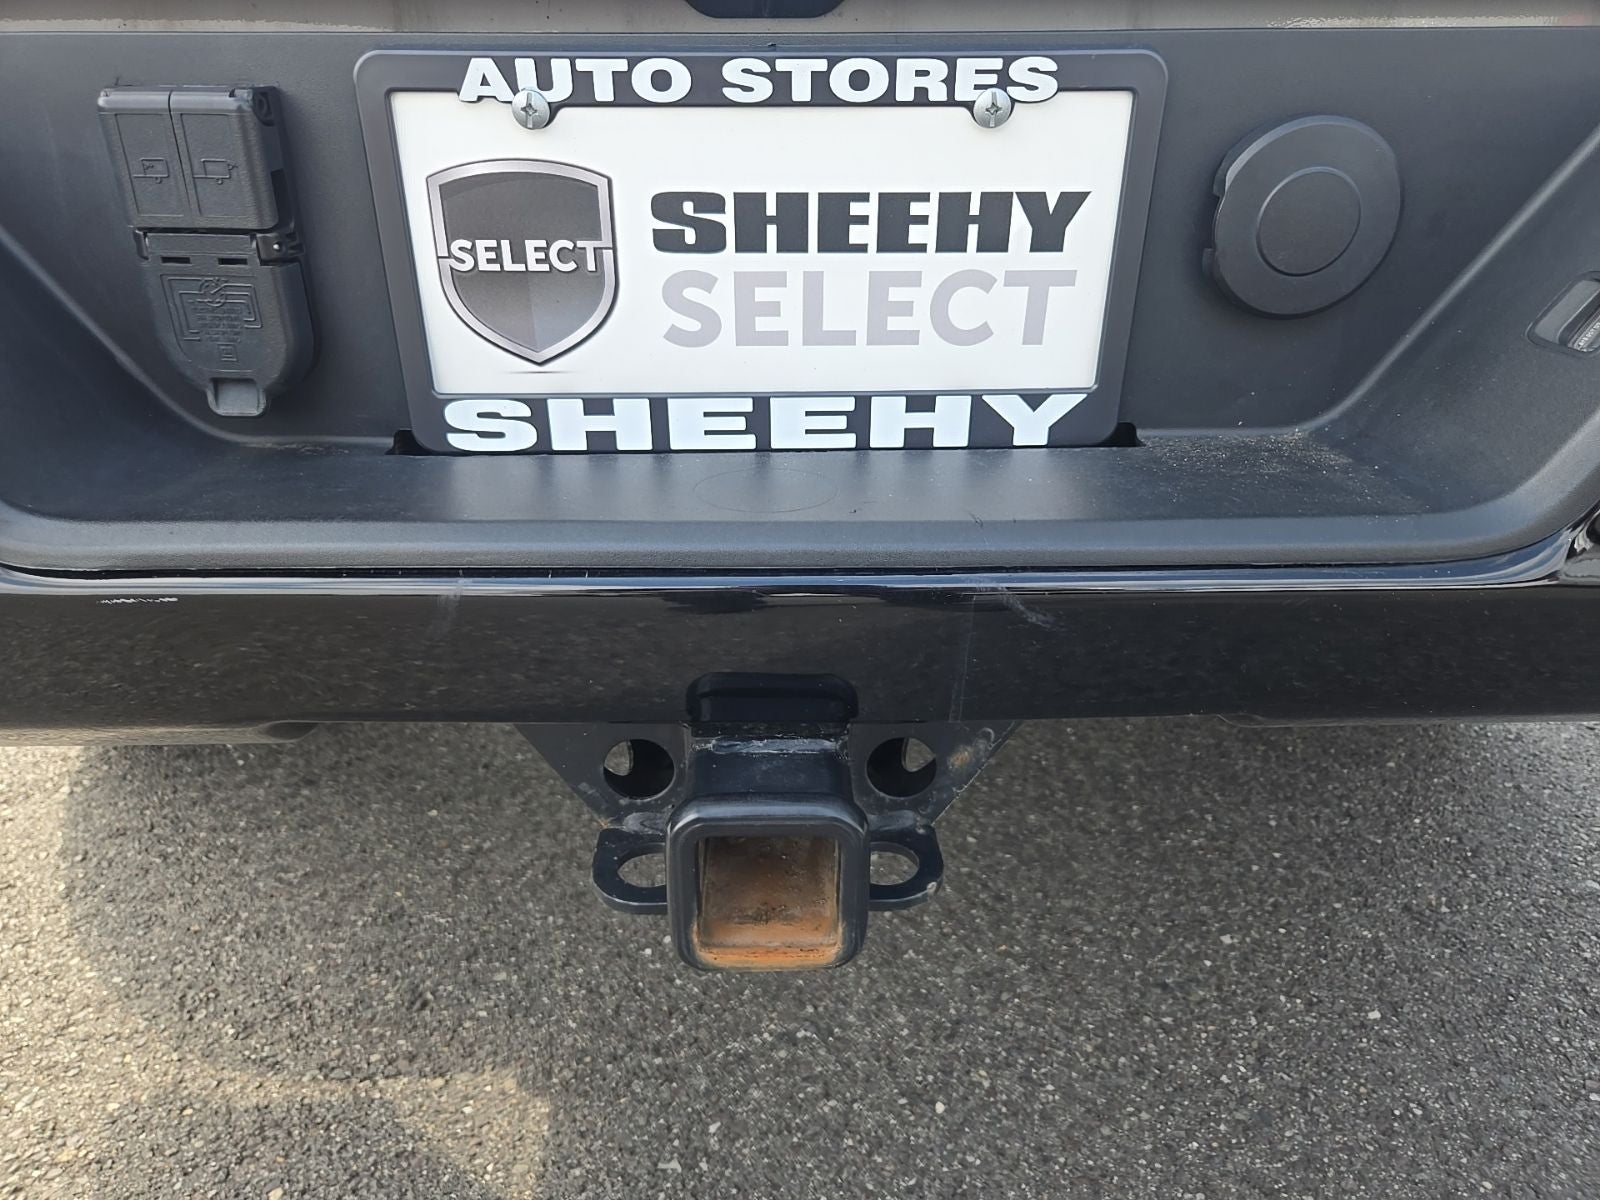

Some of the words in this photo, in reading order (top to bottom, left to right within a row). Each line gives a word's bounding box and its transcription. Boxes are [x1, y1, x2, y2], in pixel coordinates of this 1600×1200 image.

[457, 57, 692, 103] AUTO
[721, 56, 1059, 103] STORES
[652, 191, 1093, 254] SHEEHY
[449, 239, 605, 273] SELECT
[661, 268, 1078, 348] SELECT
[444, 393, 1088, 452] SHEEHY
